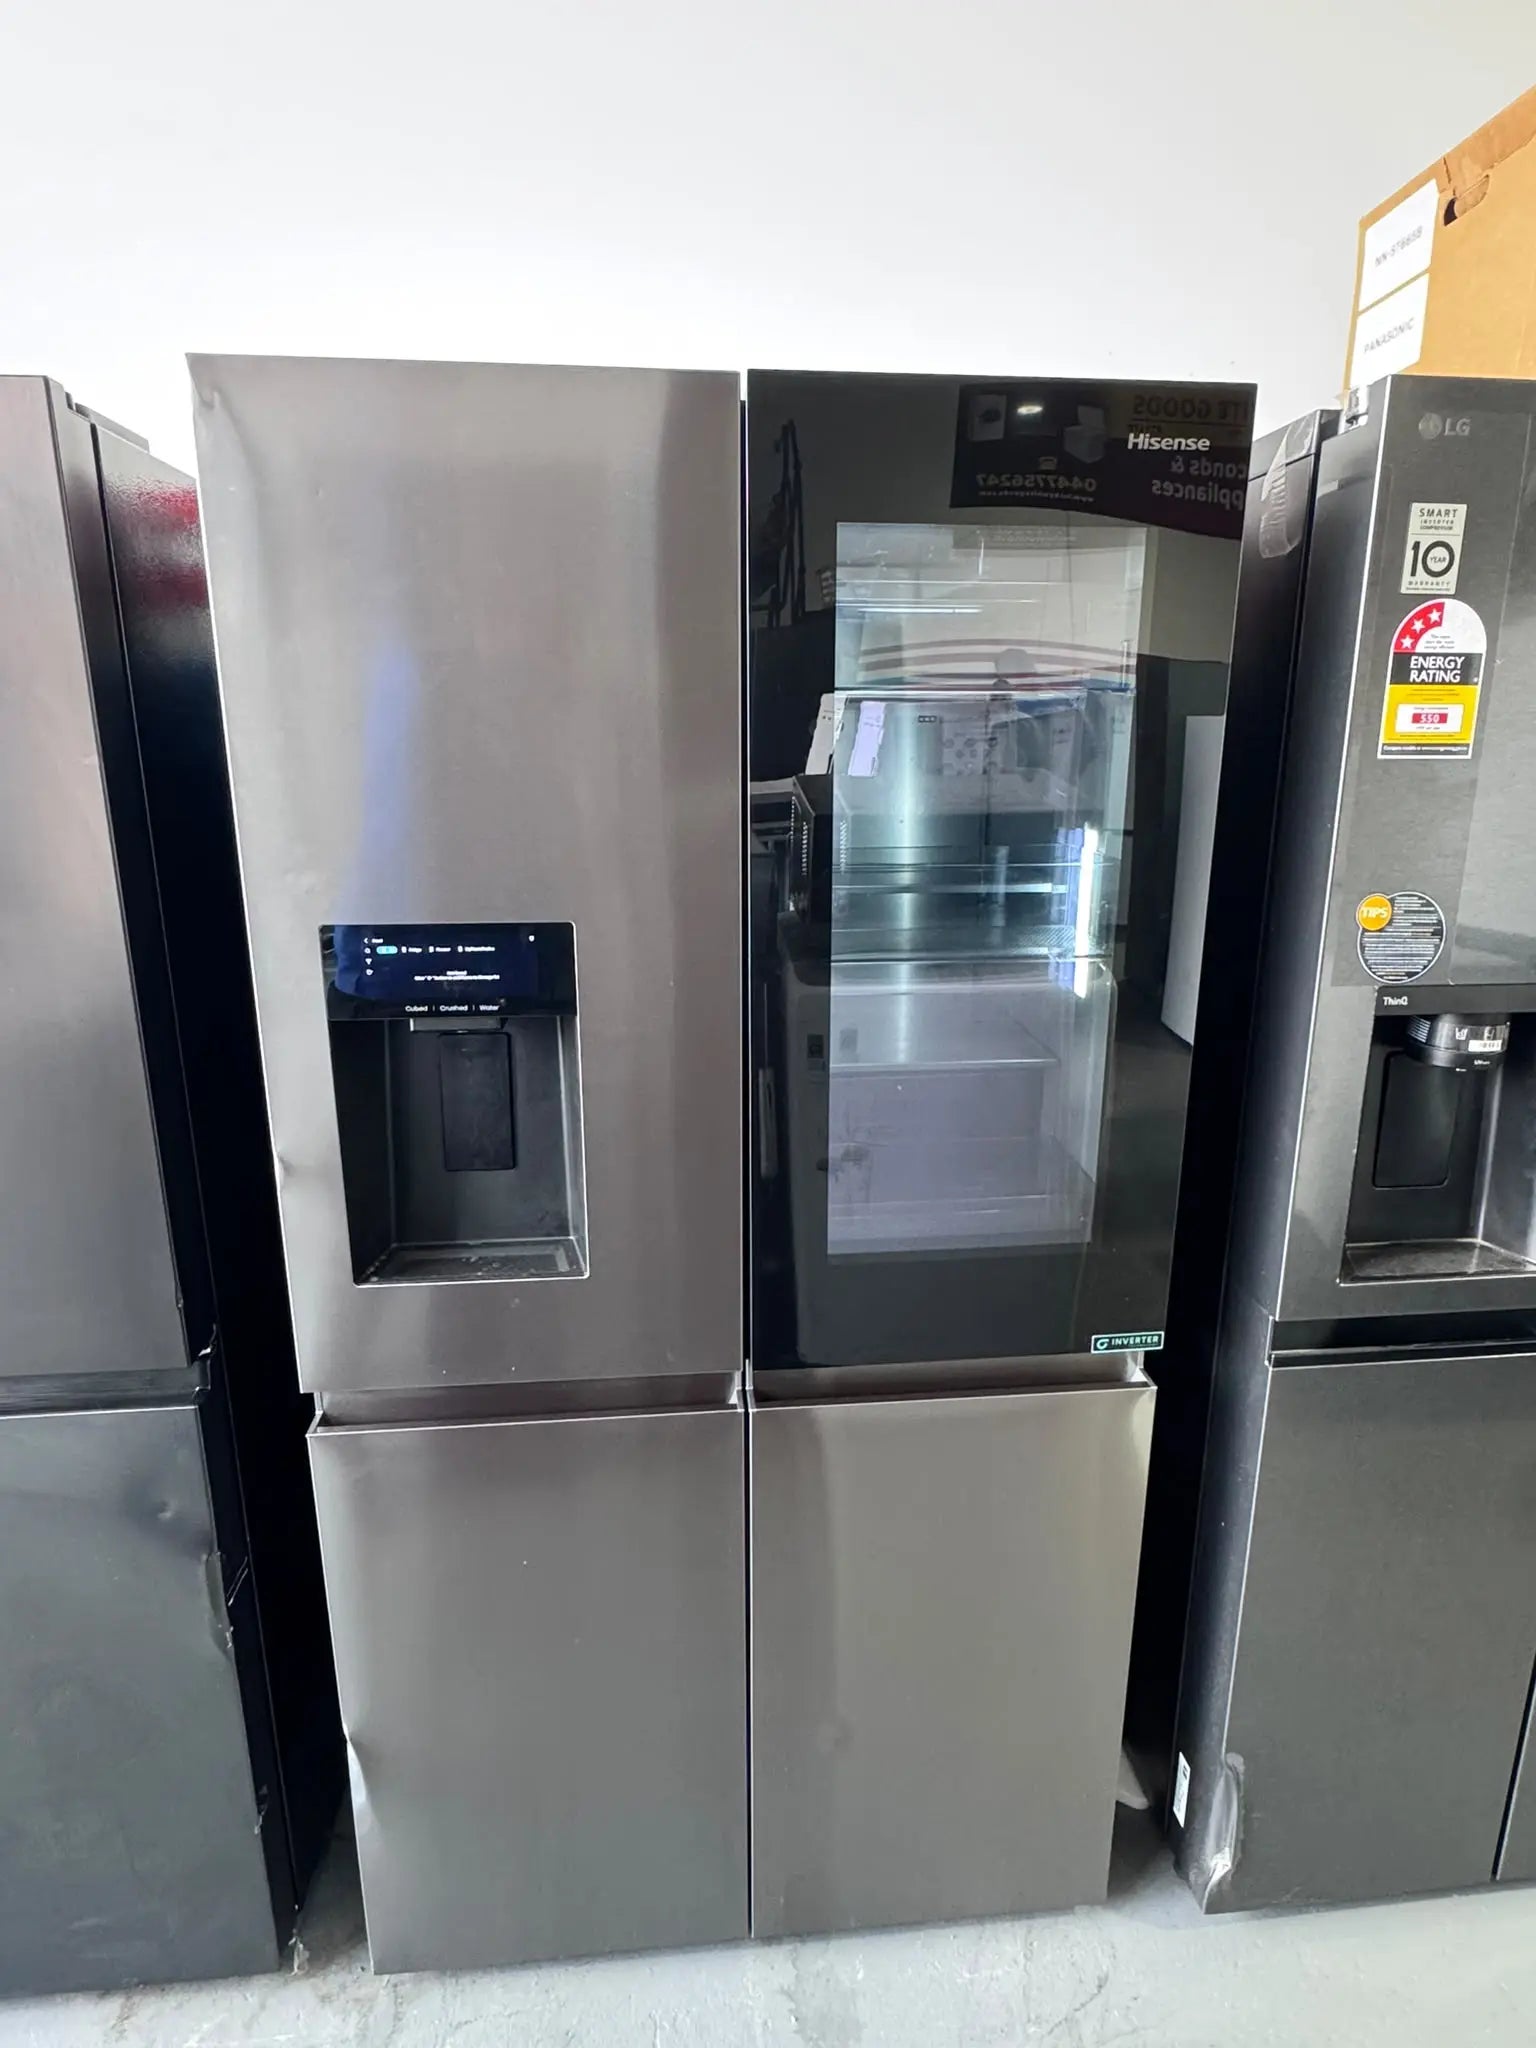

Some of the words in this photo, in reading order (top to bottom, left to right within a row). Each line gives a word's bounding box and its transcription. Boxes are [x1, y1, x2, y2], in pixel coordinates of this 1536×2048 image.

[1363, 317, 1415, 353] PANASONIC
[1444, 418, 1471, 436] LG
[1127, 432, 1210, 450] Hisense
[1419, 508, 1459, 518] SMART
[1410, 540, 1455, 578] 10
[1429, 556, 1447, 564] YEAR
[1410, 655, 1464, 669] ENERGY
[1409, 670, 1461, 683] RATING
[1361, 906, 1388, 918] TIPS
[1383, 996, 1408, 1006] ThinQ
[439, 1004, 468, 1012] Crushed
[479, 1004, 499, 1012] Water
[1111, 1335, 1159, 1346] INVERTER
